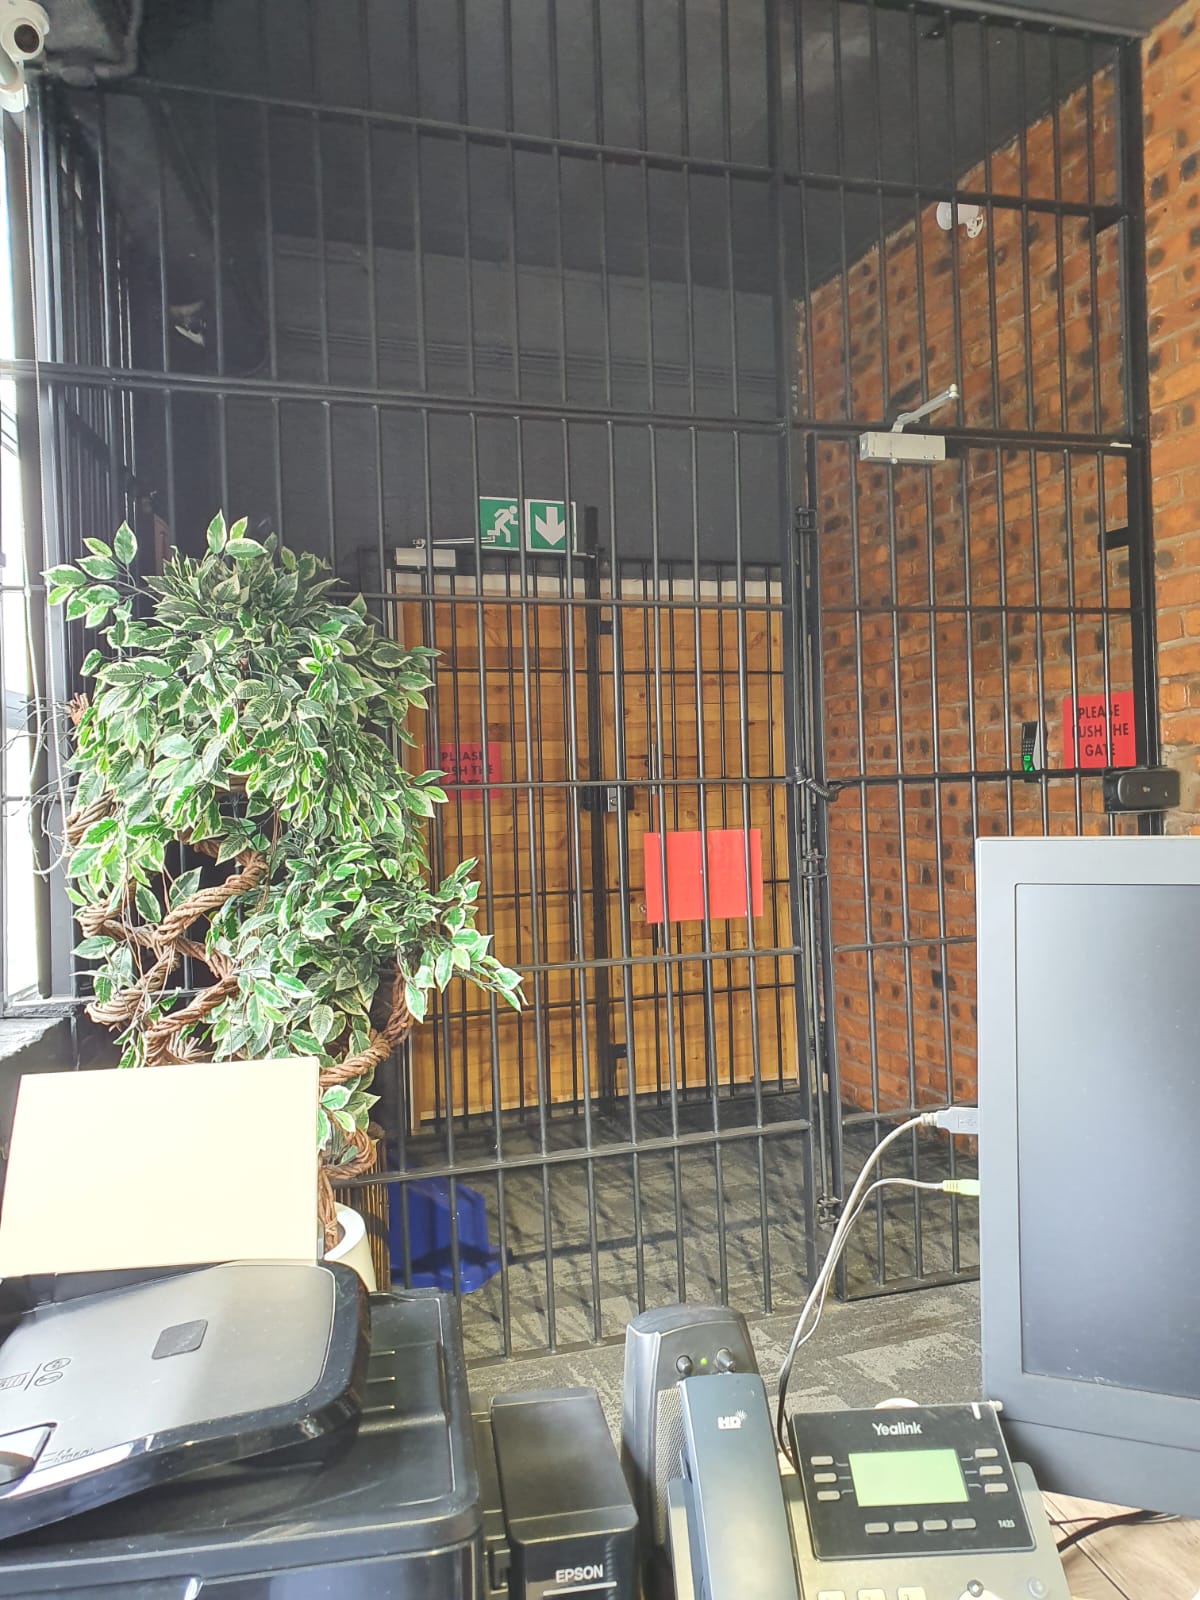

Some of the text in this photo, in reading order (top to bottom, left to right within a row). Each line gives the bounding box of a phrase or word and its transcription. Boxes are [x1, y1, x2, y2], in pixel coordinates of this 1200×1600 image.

[1073, 722, 1129, 738] USH HE
[441, 751, 487, 761] PLAS
[717, 1415, 742, 1430] HD
[871, 1421, 923, 1436] Yealink
[555, 1563, 604, 1583] EPSON
